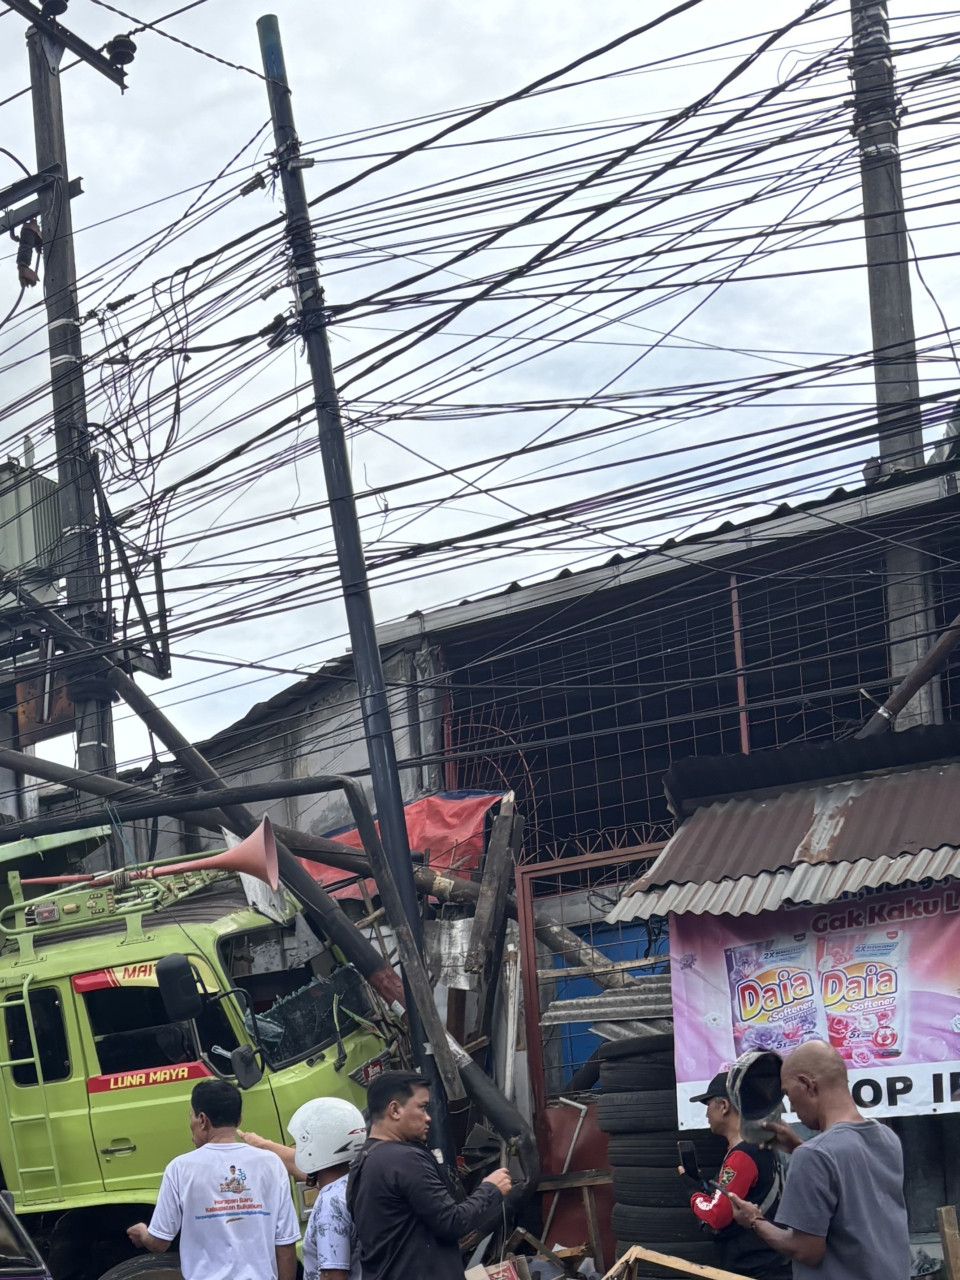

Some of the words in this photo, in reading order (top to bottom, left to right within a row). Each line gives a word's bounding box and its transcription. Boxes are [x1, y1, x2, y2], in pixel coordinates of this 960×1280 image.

[812, 909, 864, 933] Gak
[867, 899, 939, 926] Kaku
[737, 970, 814, 1022] Daia
[821, 964, 897, 1007] Daia
[110, 1073, 146, 1089] LUNA
[149, 1067, 189, 1083] MAYA
